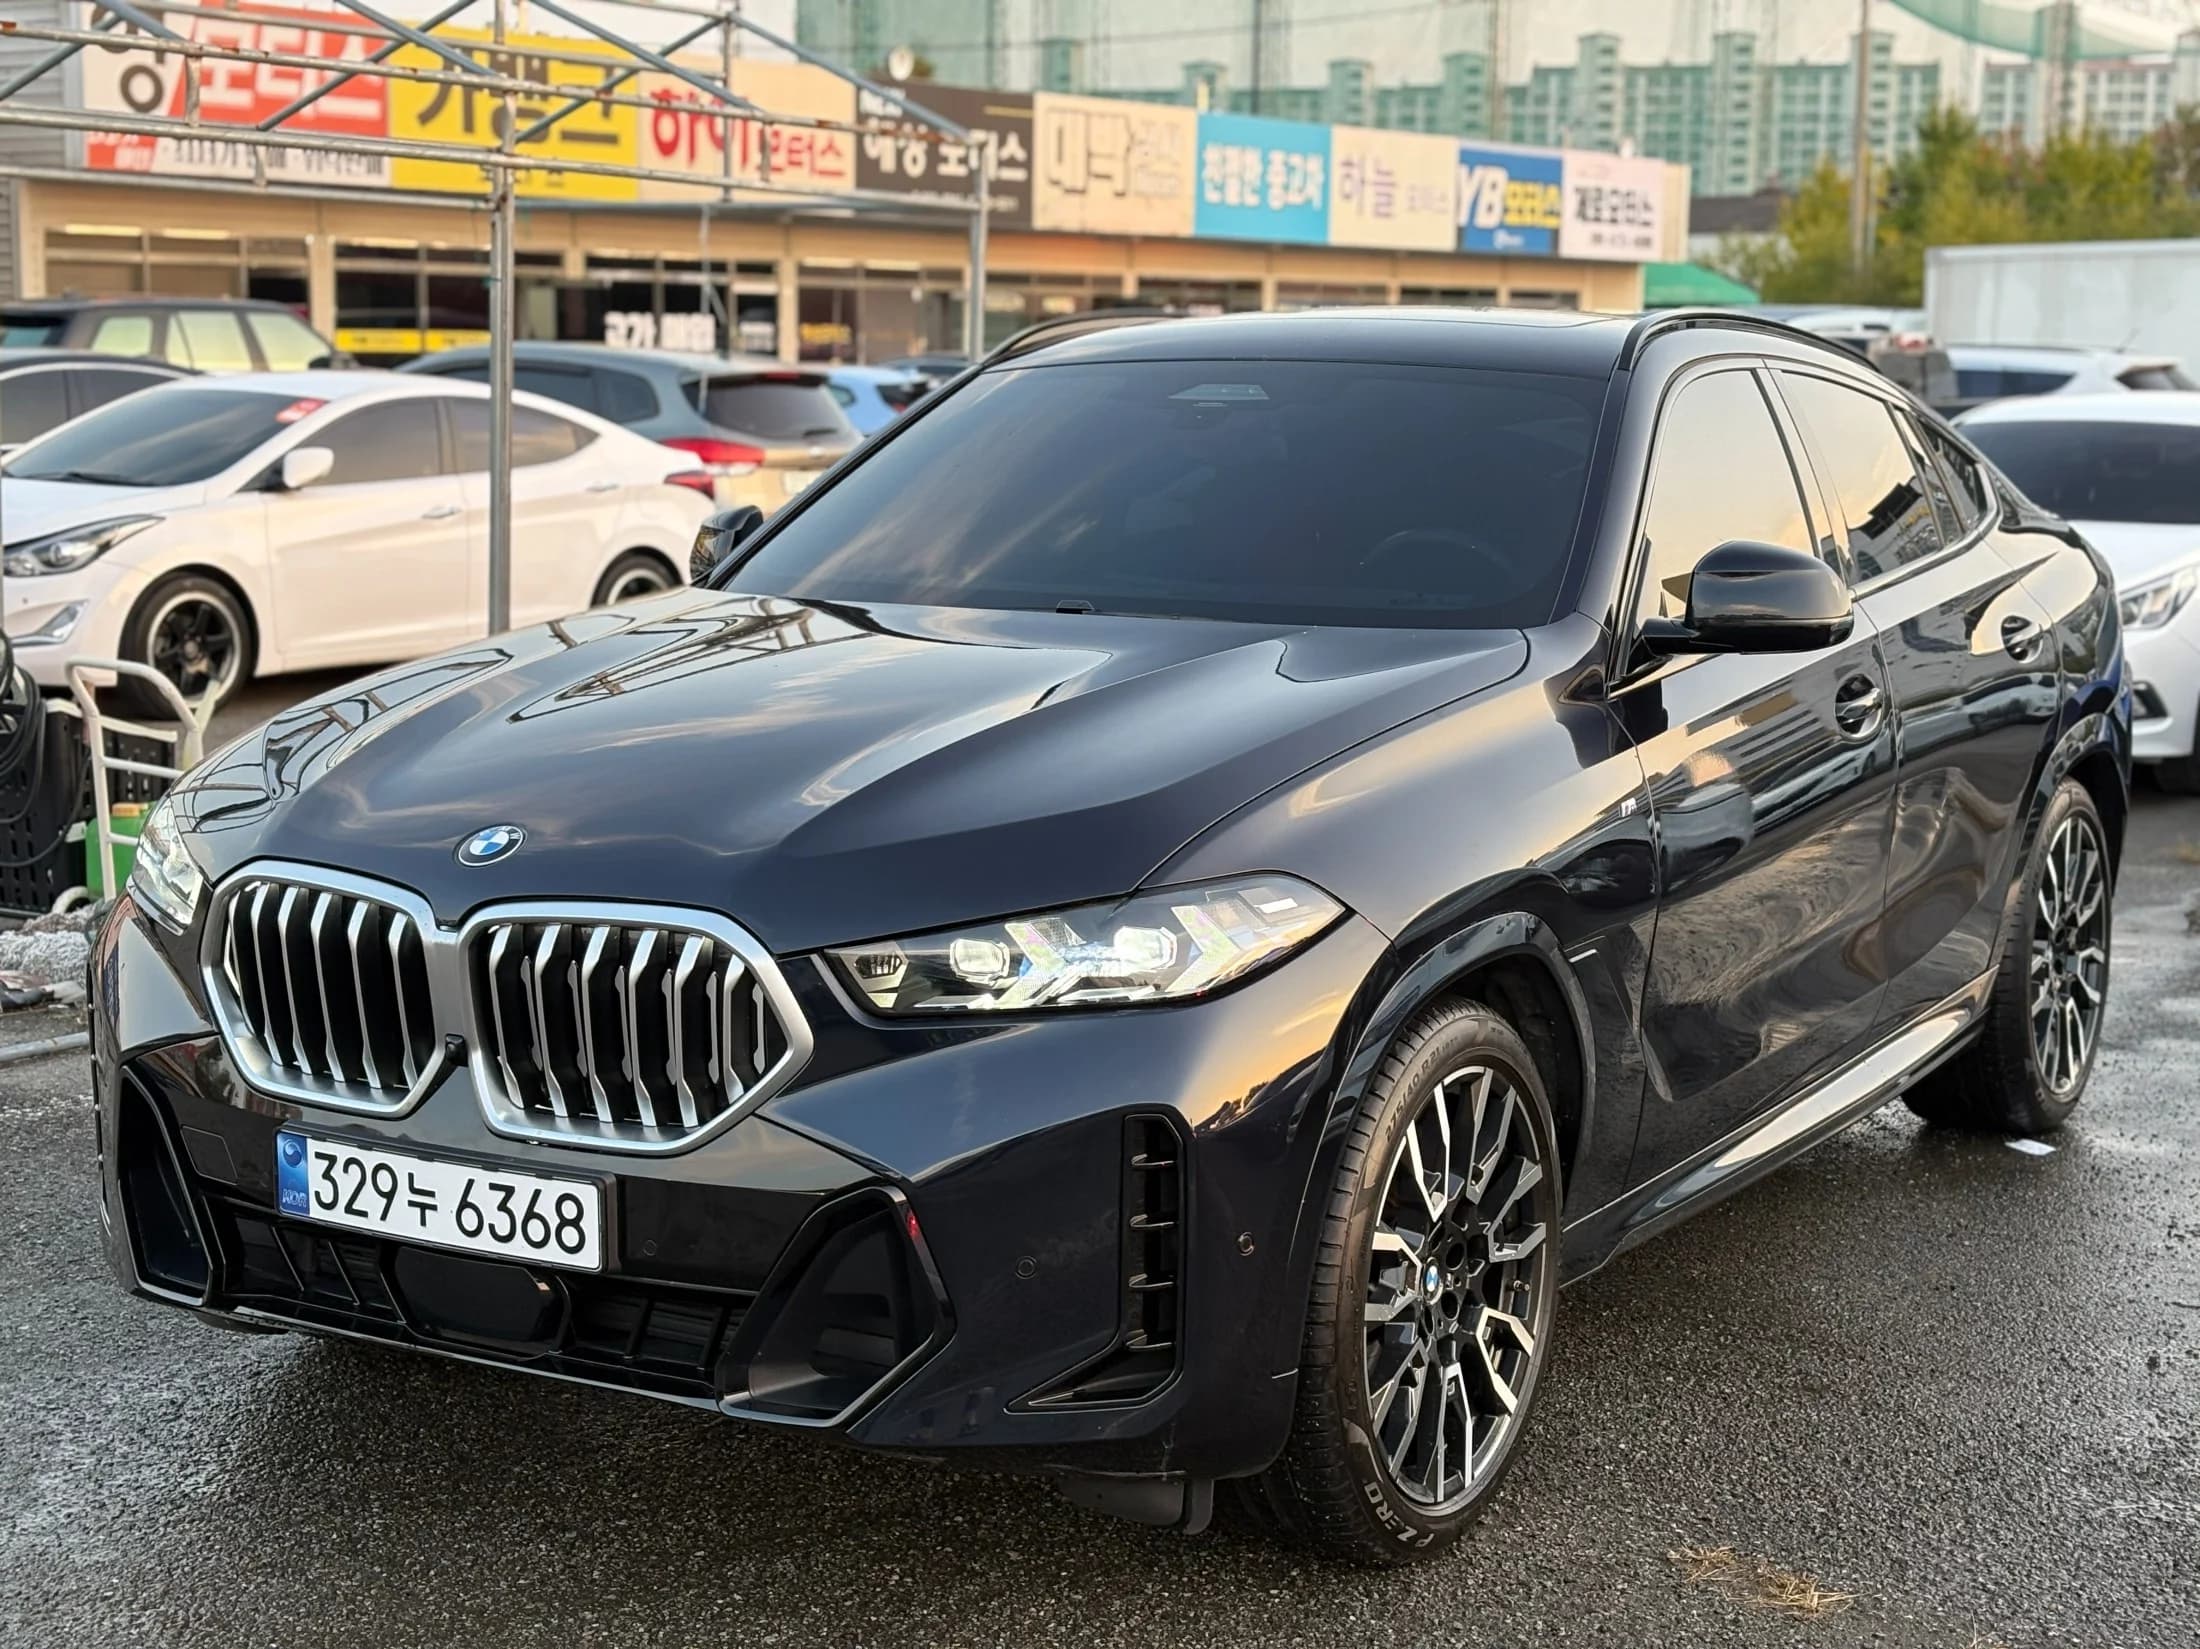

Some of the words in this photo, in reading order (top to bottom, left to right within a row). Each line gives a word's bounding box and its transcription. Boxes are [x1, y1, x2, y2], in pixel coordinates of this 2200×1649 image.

[282, 1188, 307, 1208] KOR
[313, 1151, 438, 1227] 329누
[455, 1178, 586, 1255] 6368
